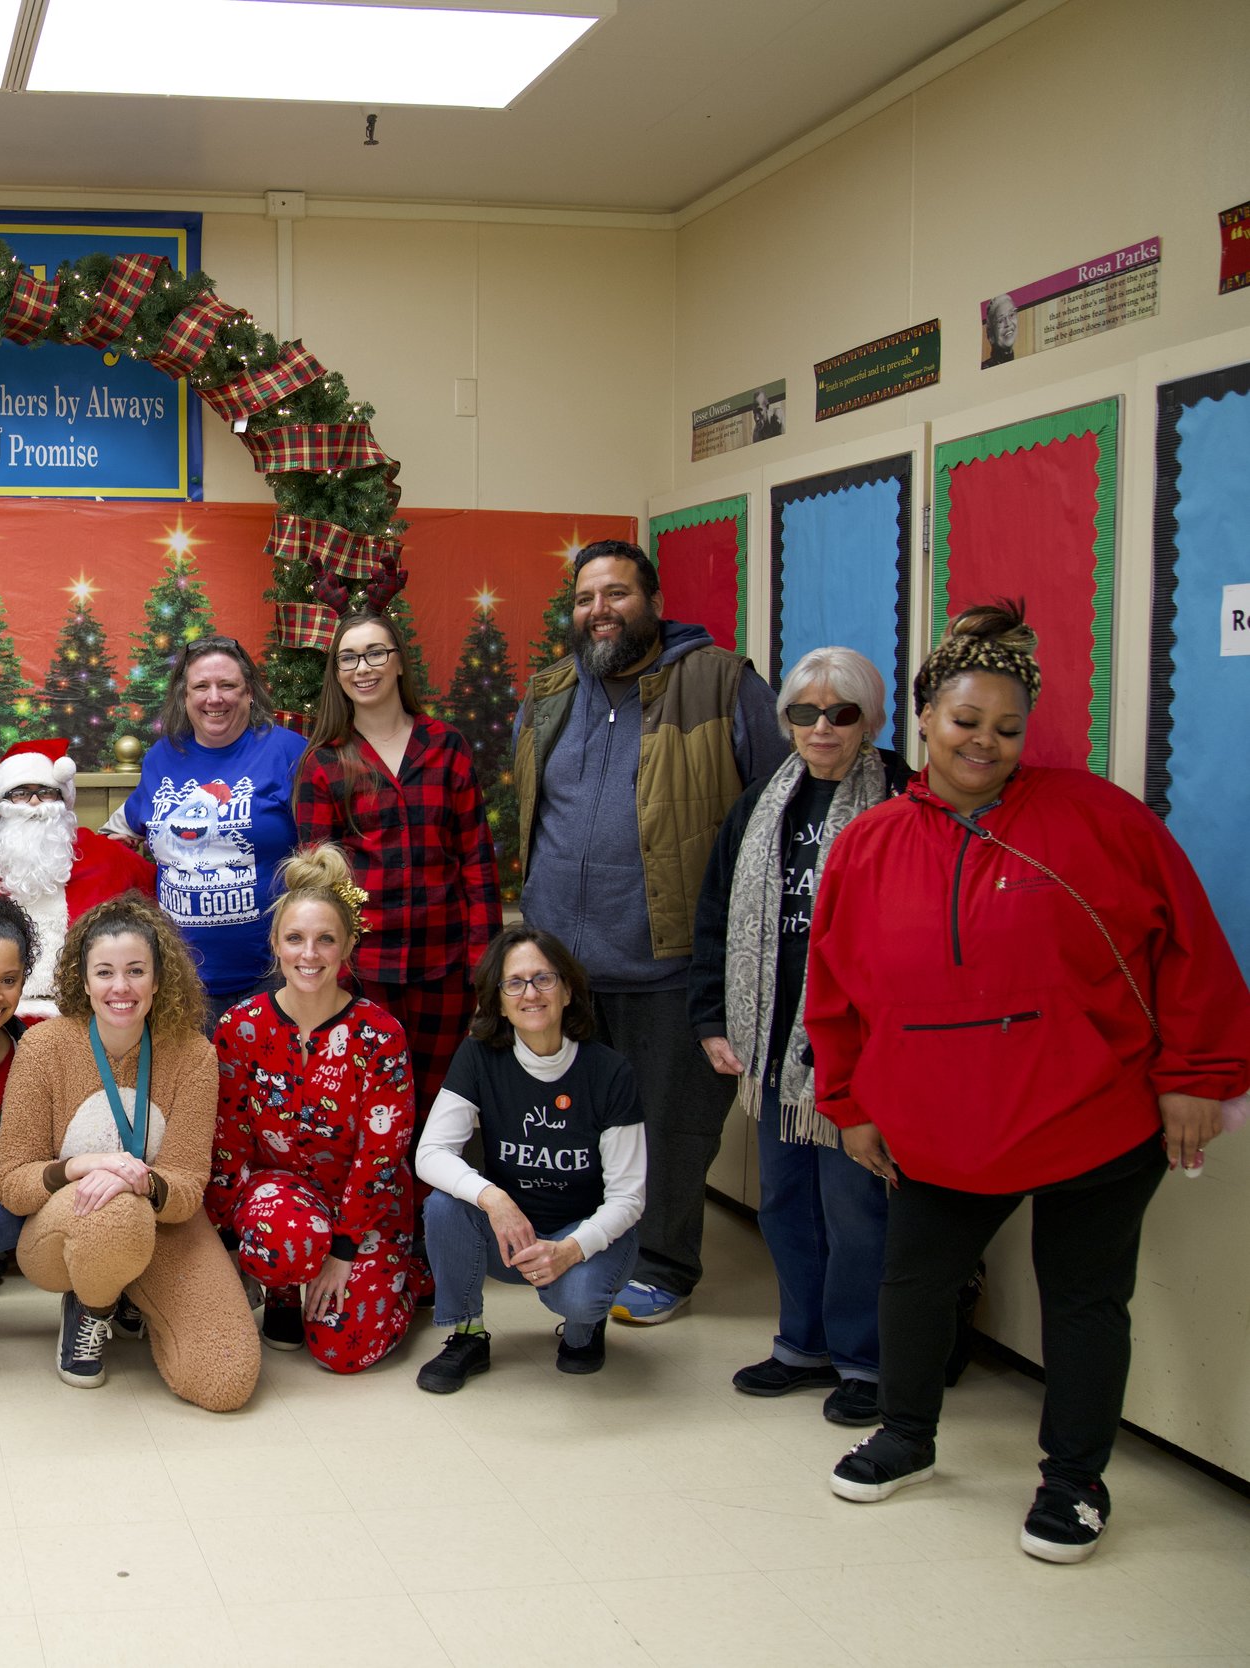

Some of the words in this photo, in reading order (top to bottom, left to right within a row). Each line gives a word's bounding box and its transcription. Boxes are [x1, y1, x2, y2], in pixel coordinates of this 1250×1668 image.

[1078, 260, 1111, 283] Rosa
[1115, 243, 1157, 269] Parks
[1049, 311, 1060, 321] that
[1062, 306, 1079, 316] when
[1081, 299, 1097, 310] one's
[1099, 291, 1116, 304] mind
[1118, 290, 1124, 298] is
[1126, 284, 1145, 295] made
[1067, 293, 1082, 304] have
[1084, 282, 1108, 298] learned
[1110, 279, 1126, 289] over
[1127, 274, 1138, 283] the
[1140, 268, 1158, 281] years
[1044, 324, 1055, 333] this
[1056, 314, 1091, 329] diminishes
[1108, 298, 1139, 312] knowing
[1140, 291, 1158, 301] what
[1044, 335, 1059, 345] must
[1060, 331, 1068, 340] be
[1069, 327, 1085, 337] done
[1086, 321, 1101, 331] does
[1102, 316, 1119, 326] away
[1121, 308, 1136, 319] with
[839, 378, 844, 387] is
[844, 369, 867, 388] powerful
[868, 364, 880, 377] and
[880, 364, 886, 373] it
[55, 384, 80, 425] by
[85, 386, 165, 426] Always
[693, 411, 708, 426] Jesse
[708, 403, 731, 418] Owens
[8, 436, 99, 468] Promise
[152, 801, 172, 821] UP
[230, 799, 251, 820] TO
[160, 881, 192, 915] SNOW
[199, 887, 256, 916] GOOD
[522, 1105, 566, 1138] سلام
[498, 1140, 590, 1171] PEACE
